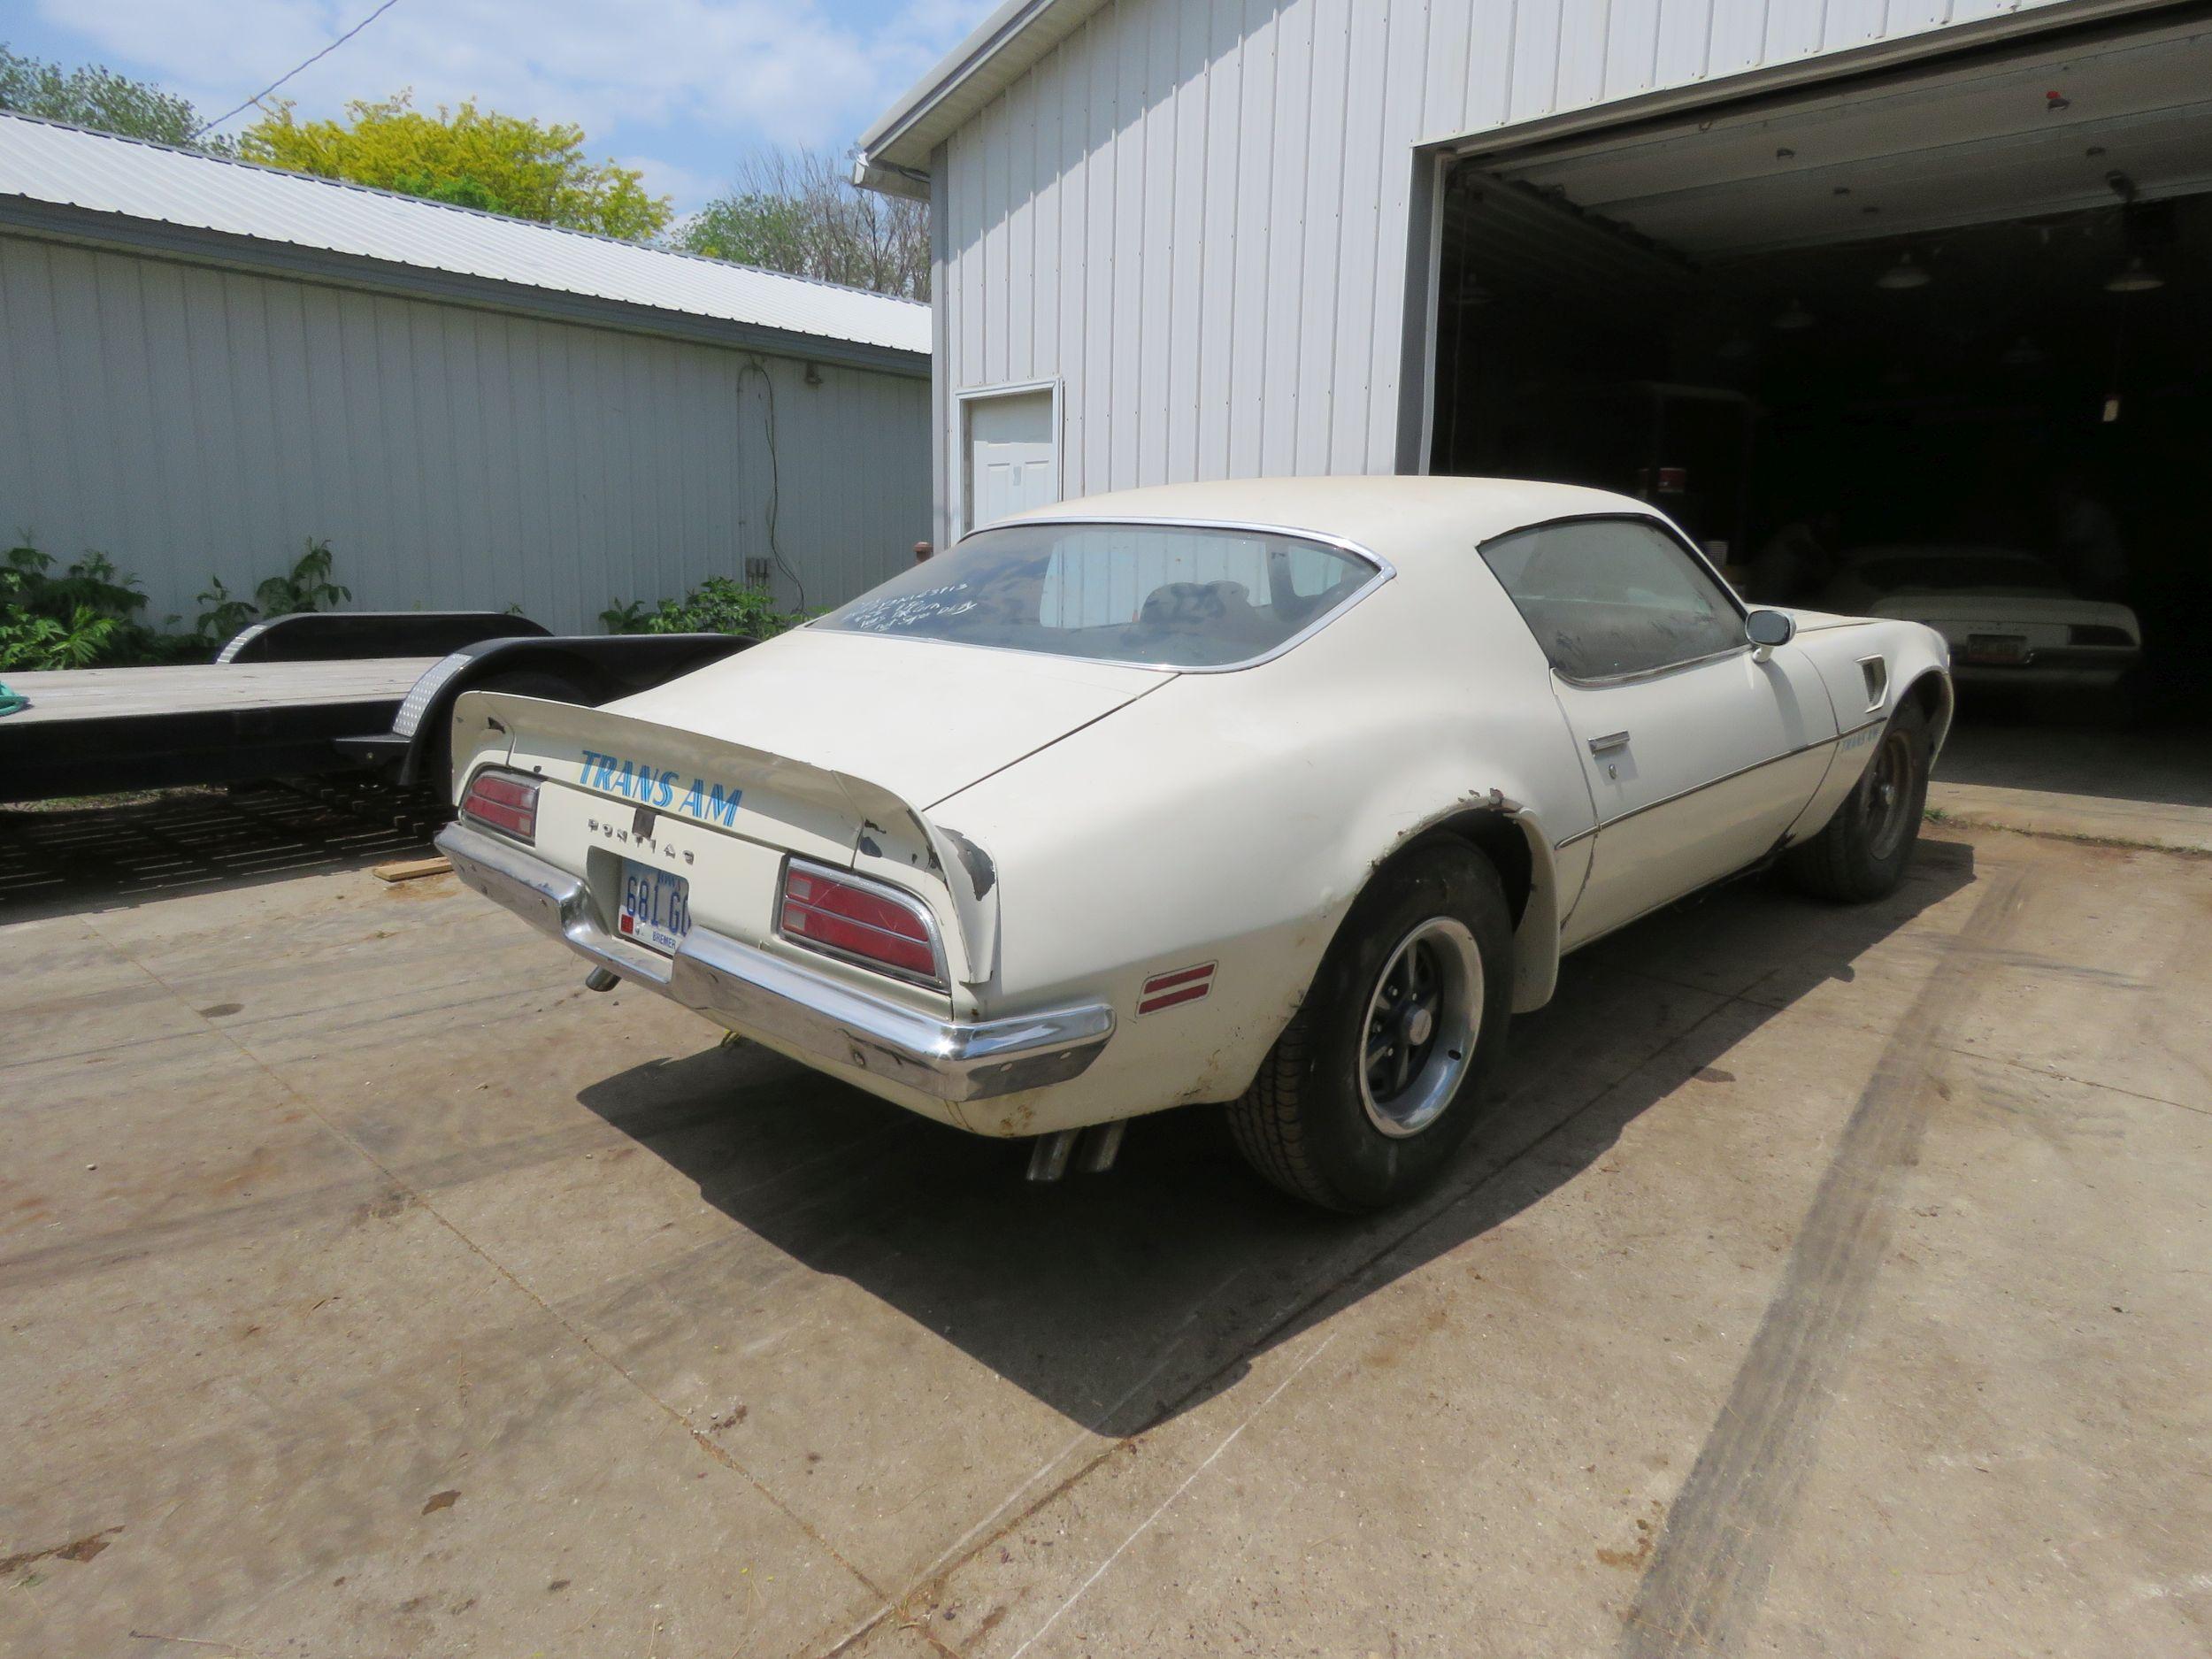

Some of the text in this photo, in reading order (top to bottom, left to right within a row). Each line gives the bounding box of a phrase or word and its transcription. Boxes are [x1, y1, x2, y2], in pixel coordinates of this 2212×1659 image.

[580, 750, 742, 827] TRANS AM
[588, 818, 694, 865] PONTIAC
[626, 876, 658, 926] 681
[652, 931, 677, 949] BREMER
